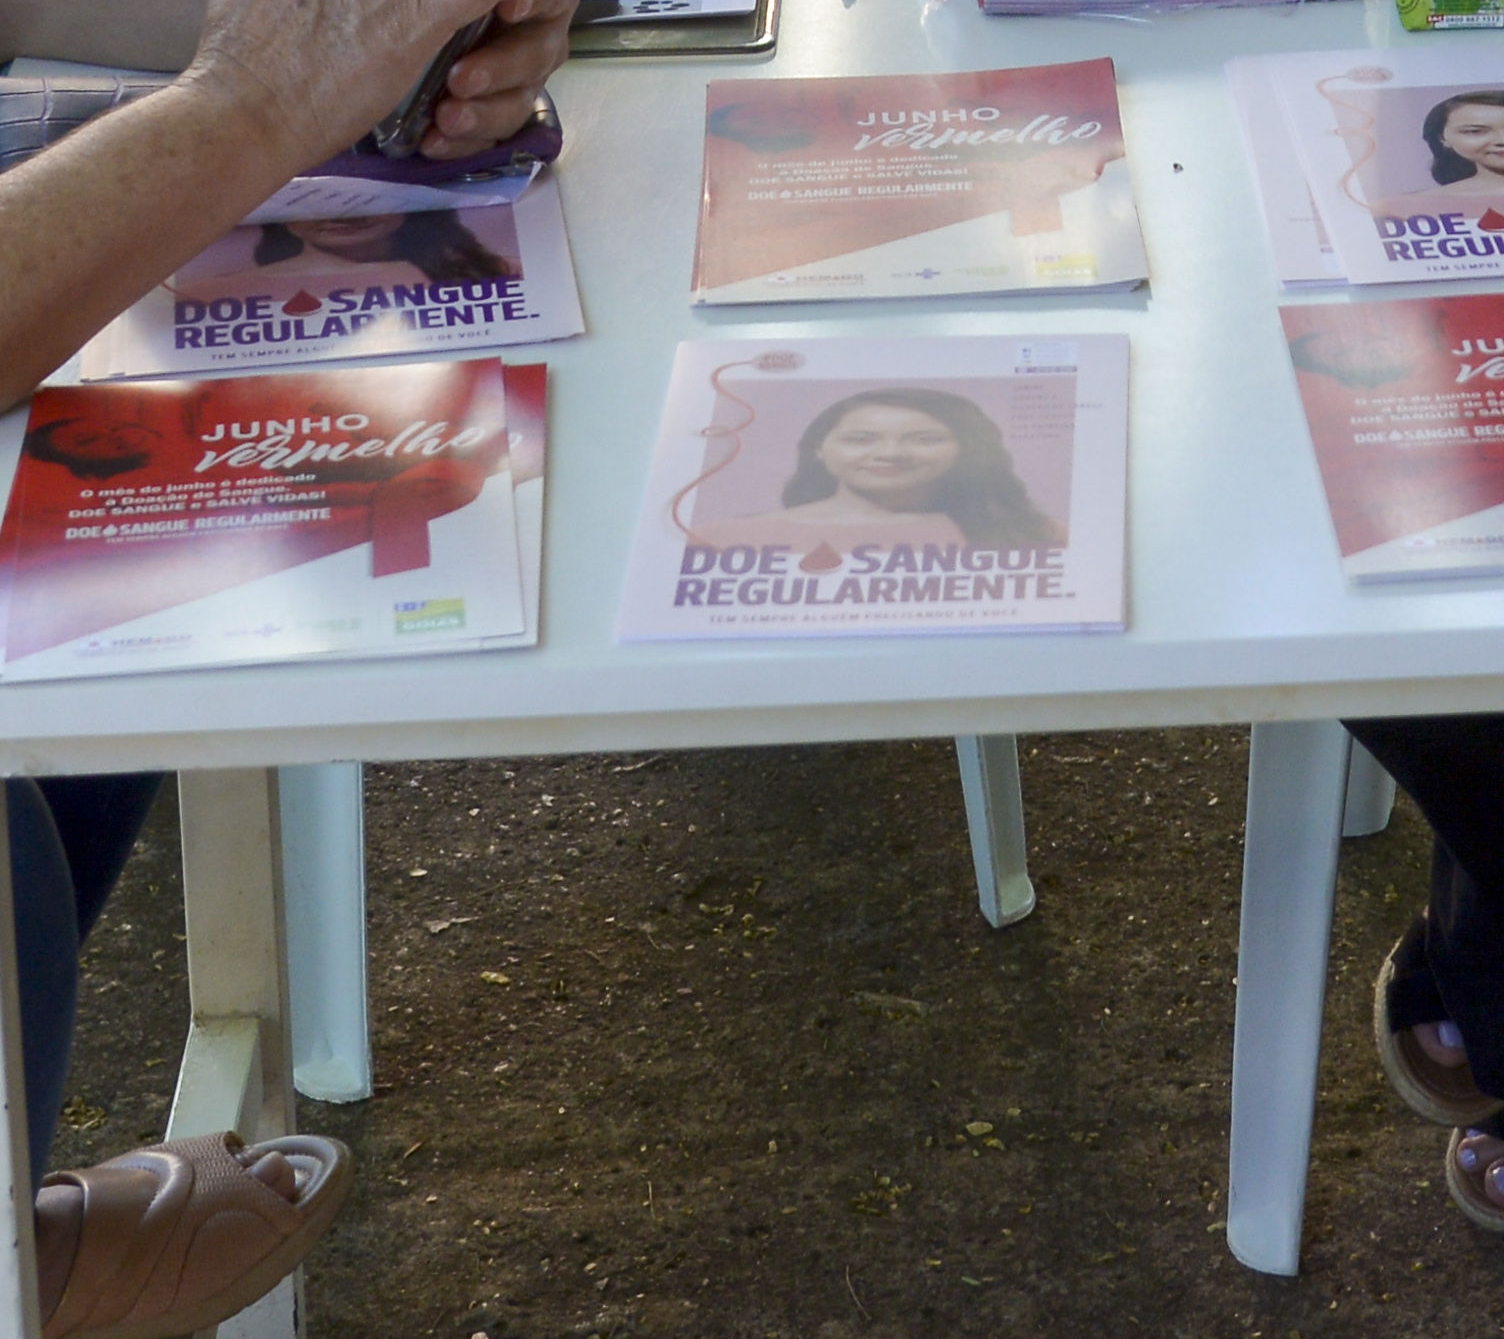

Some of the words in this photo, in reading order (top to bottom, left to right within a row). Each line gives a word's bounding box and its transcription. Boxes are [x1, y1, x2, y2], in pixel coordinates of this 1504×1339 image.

[856, 108, 1000, 125] JUNHO
[854, 114, 1101, 151] vermelho
[748, 189, 777, 200] DOE
[792, 187, 851, 199] SANGUE
[857, 182, 974, 197] REGULARMENTE
[1376, 212, 1472, 239] DOE
[175, 296, 273, 324] DOE
[328, 282, 524, 314] SANGUE
[202, 413, 371, 442] JUNHO
[1353, 431, 1388, 444] DOE
[1403, 426, 1469, 440] SANGUE
[194, 419, 484, 474] vermelho
[68, 505, 107, 519] DOE
[111, 500, 186, 516] SANGUE
[207, 494, 263, 509] SALVE
[267, 488, 327, 503] VIDAS!
[65, 526, 103, 540] DOE
[119, 518, 191, 536] SANGUE
[195, 506, 332, 529] REGULARMENTE
[680, 544, 790, 575] DOE
[849, 544, 1064, 574] SANGUE
[674, 573, 1076, 606] REGULARMENTE.
